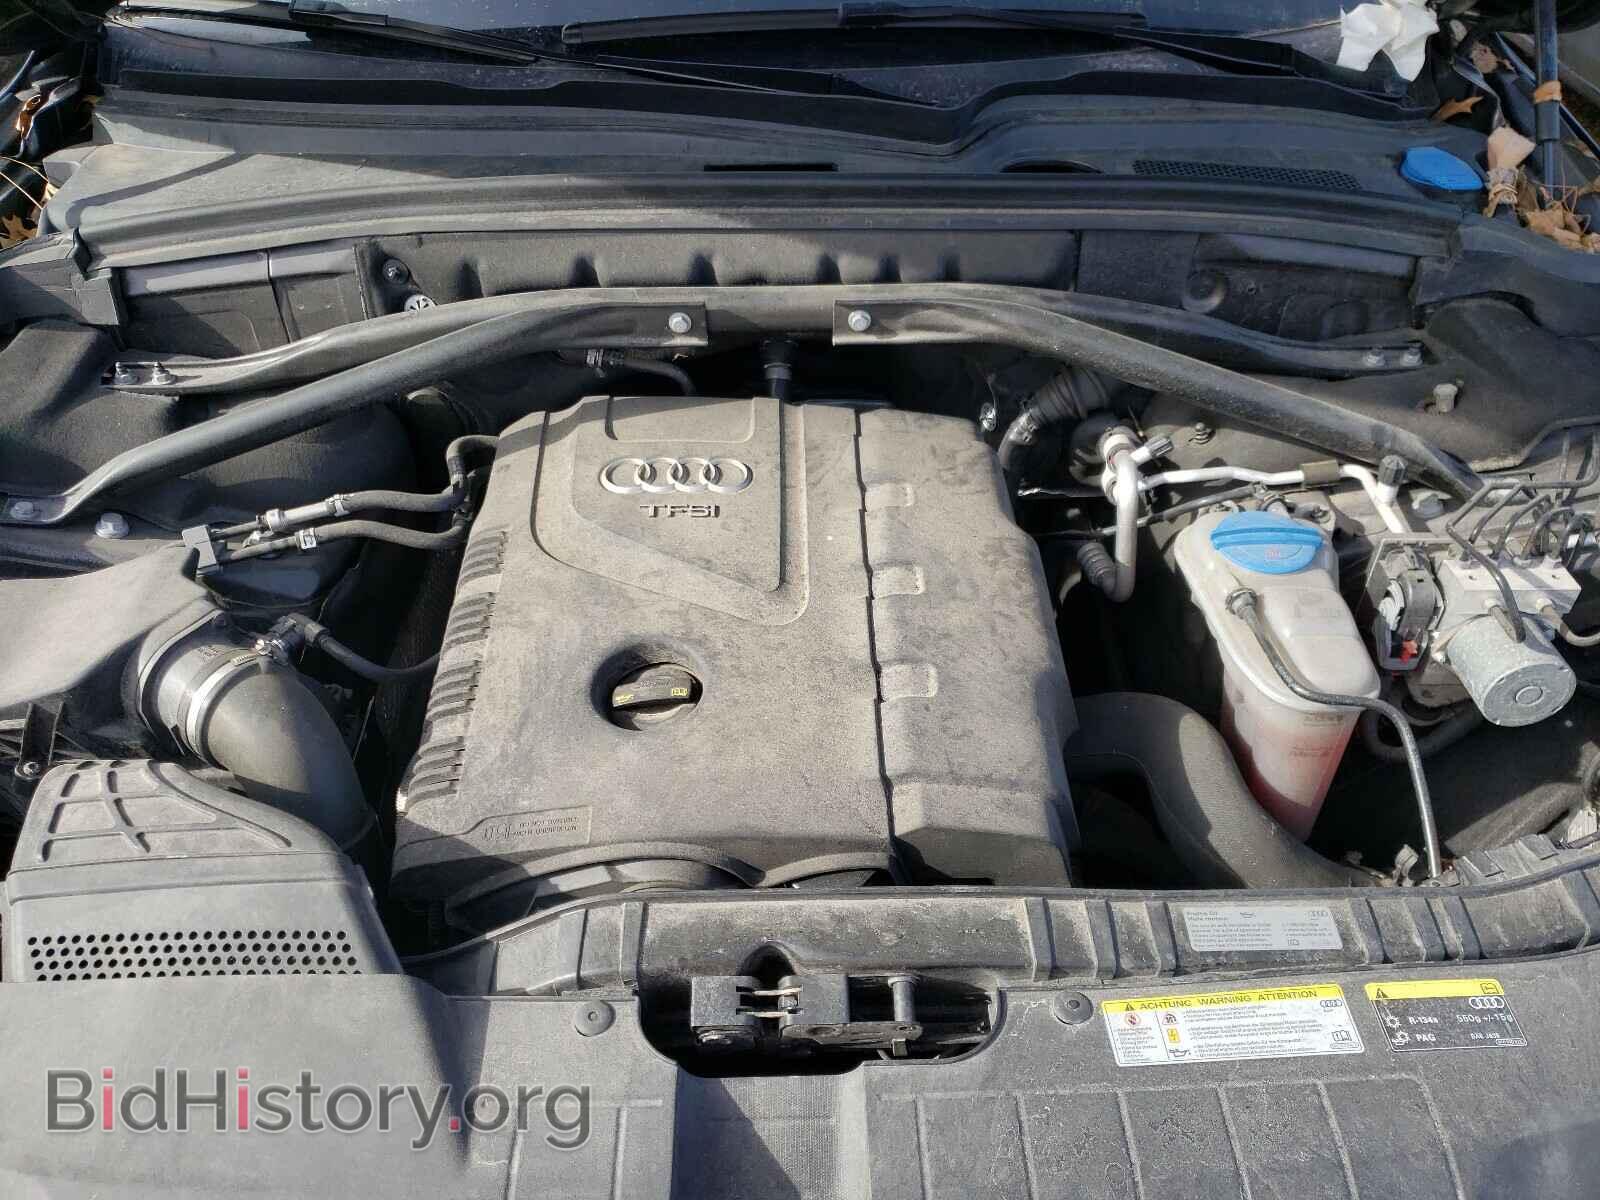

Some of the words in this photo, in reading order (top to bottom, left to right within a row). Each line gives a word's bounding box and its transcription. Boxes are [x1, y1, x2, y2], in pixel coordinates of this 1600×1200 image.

[639, 503, 721, 519] TFSI
[1139, 998, 1192, 1010] ACHTUNG
[1199, 994, 1252, 1006] WARNING
[1258, 989, 1318, 1001] ATTENTION
[1415, 1033, 1437, 1042] PAG
